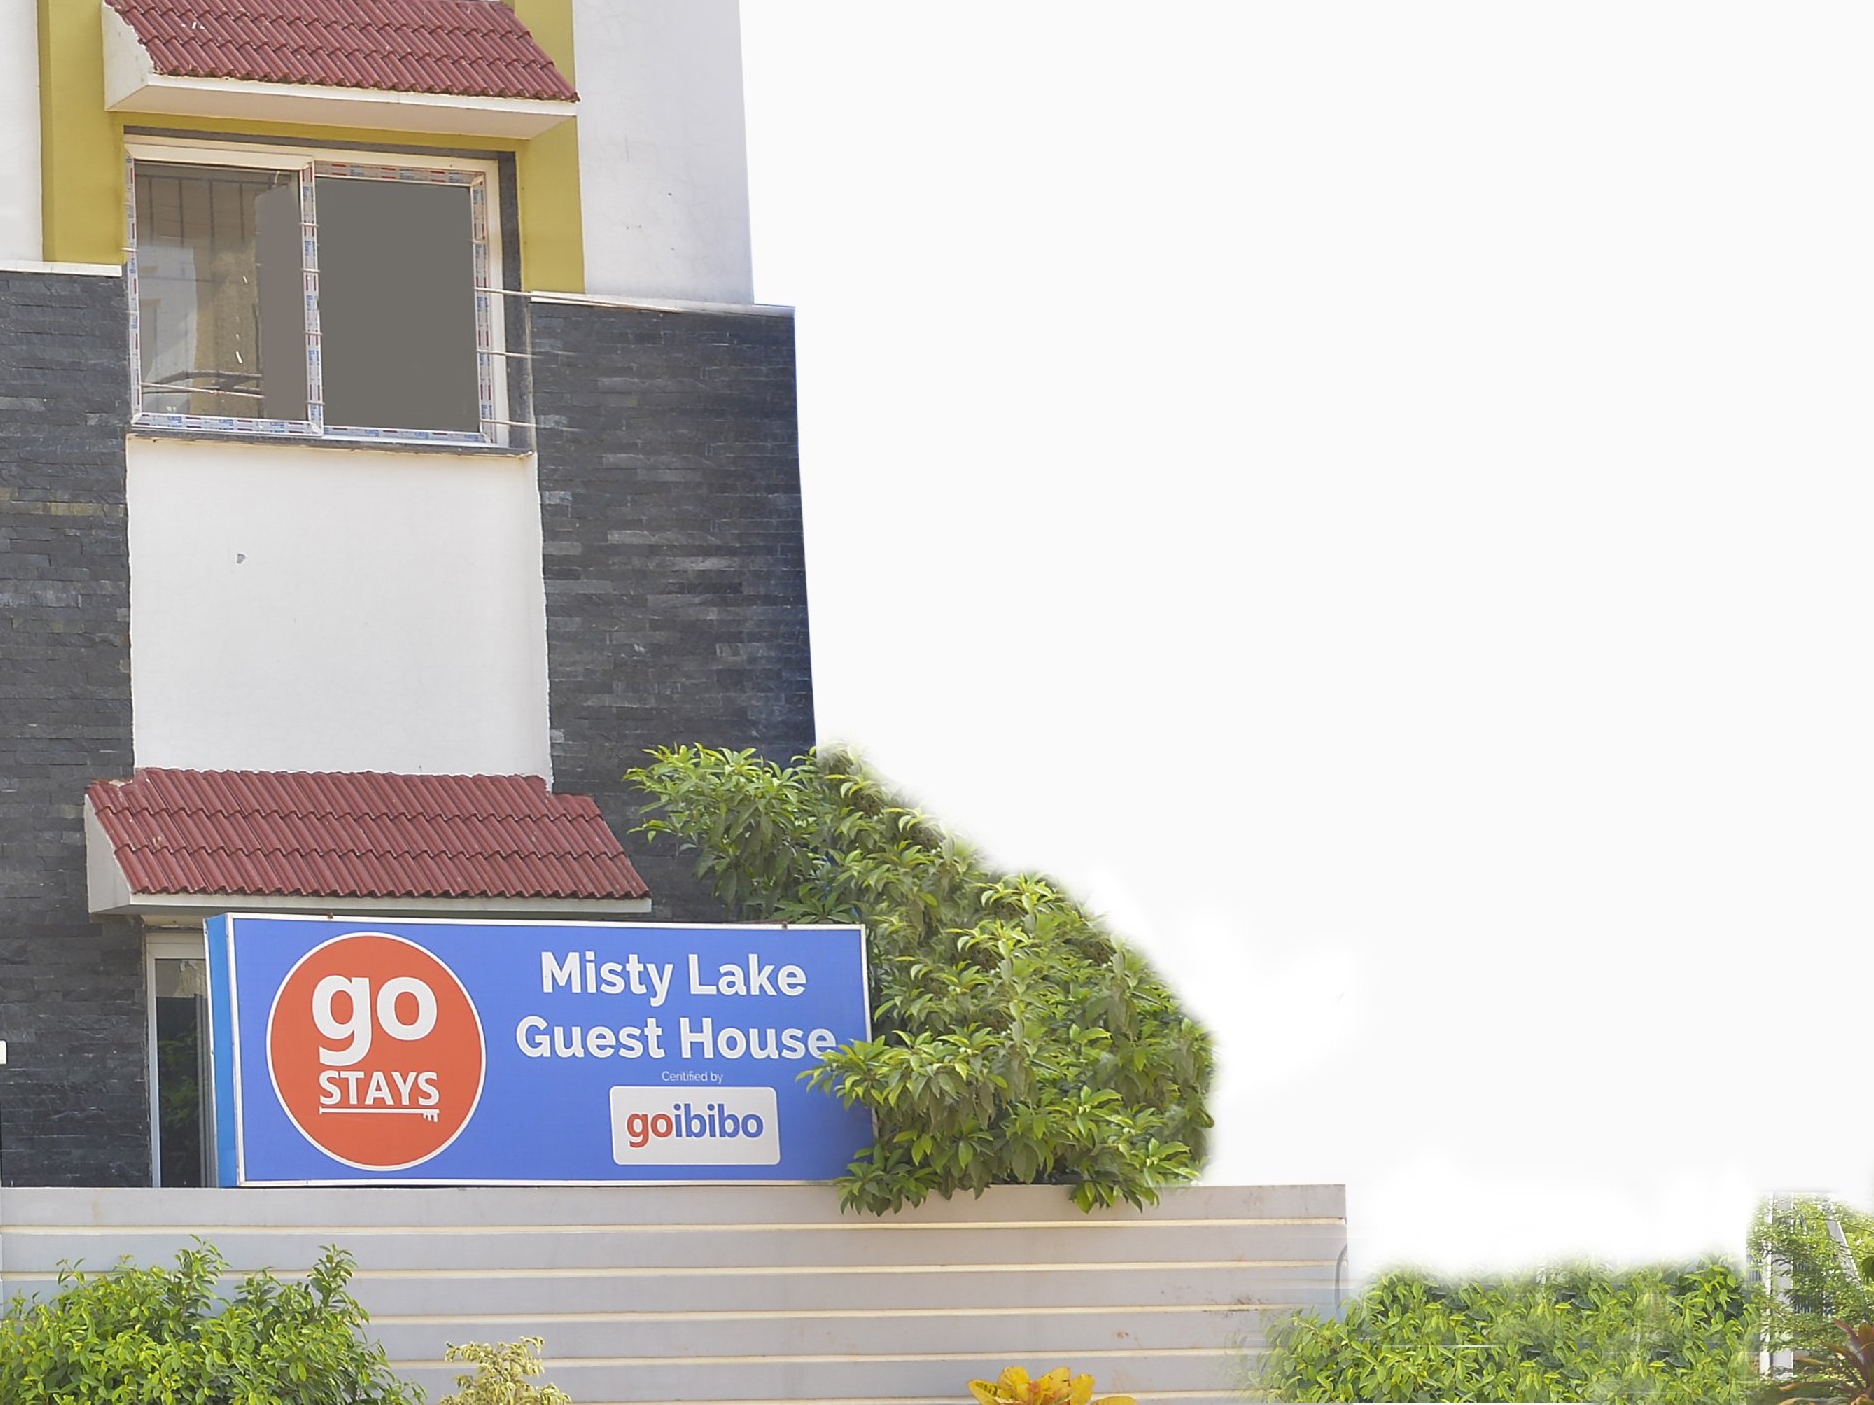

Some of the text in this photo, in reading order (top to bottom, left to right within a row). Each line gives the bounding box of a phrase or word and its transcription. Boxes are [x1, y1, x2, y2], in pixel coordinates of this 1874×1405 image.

[540, 950, 807, 1007] Misty Lake
[311, 975, 438, 1066] go
[515, 1015, 837, 1059] Guest House
[318, 1070, 440, 1106] STAYS
[661, 1070, 724, 1085] Certified by
[626, 1103, 764, 1148] goibibo
